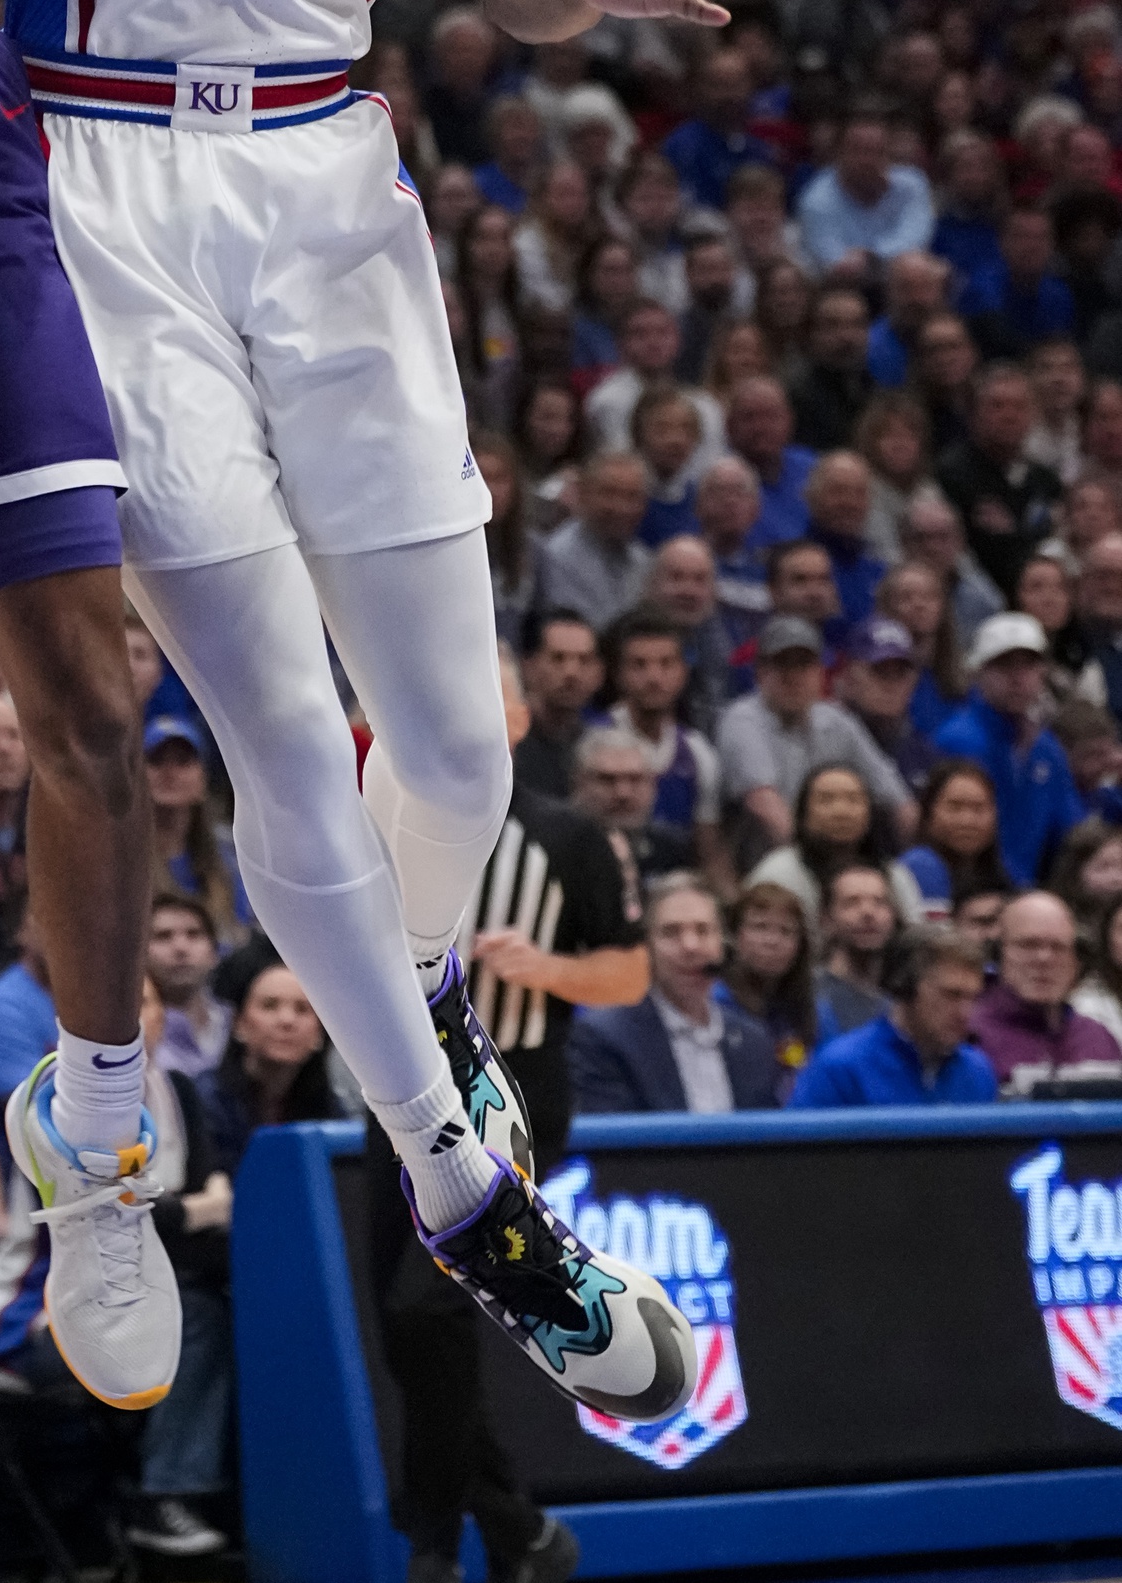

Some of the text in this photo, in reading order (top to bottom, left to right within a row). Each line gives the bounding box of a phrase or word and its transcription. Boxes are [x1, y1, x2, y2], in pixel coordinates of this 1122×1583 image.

[189, 81, 241, 115] KU
[1010, 1148, 1122, 1263] Tea
[1032, 1266, 1122, 1304] IMP
